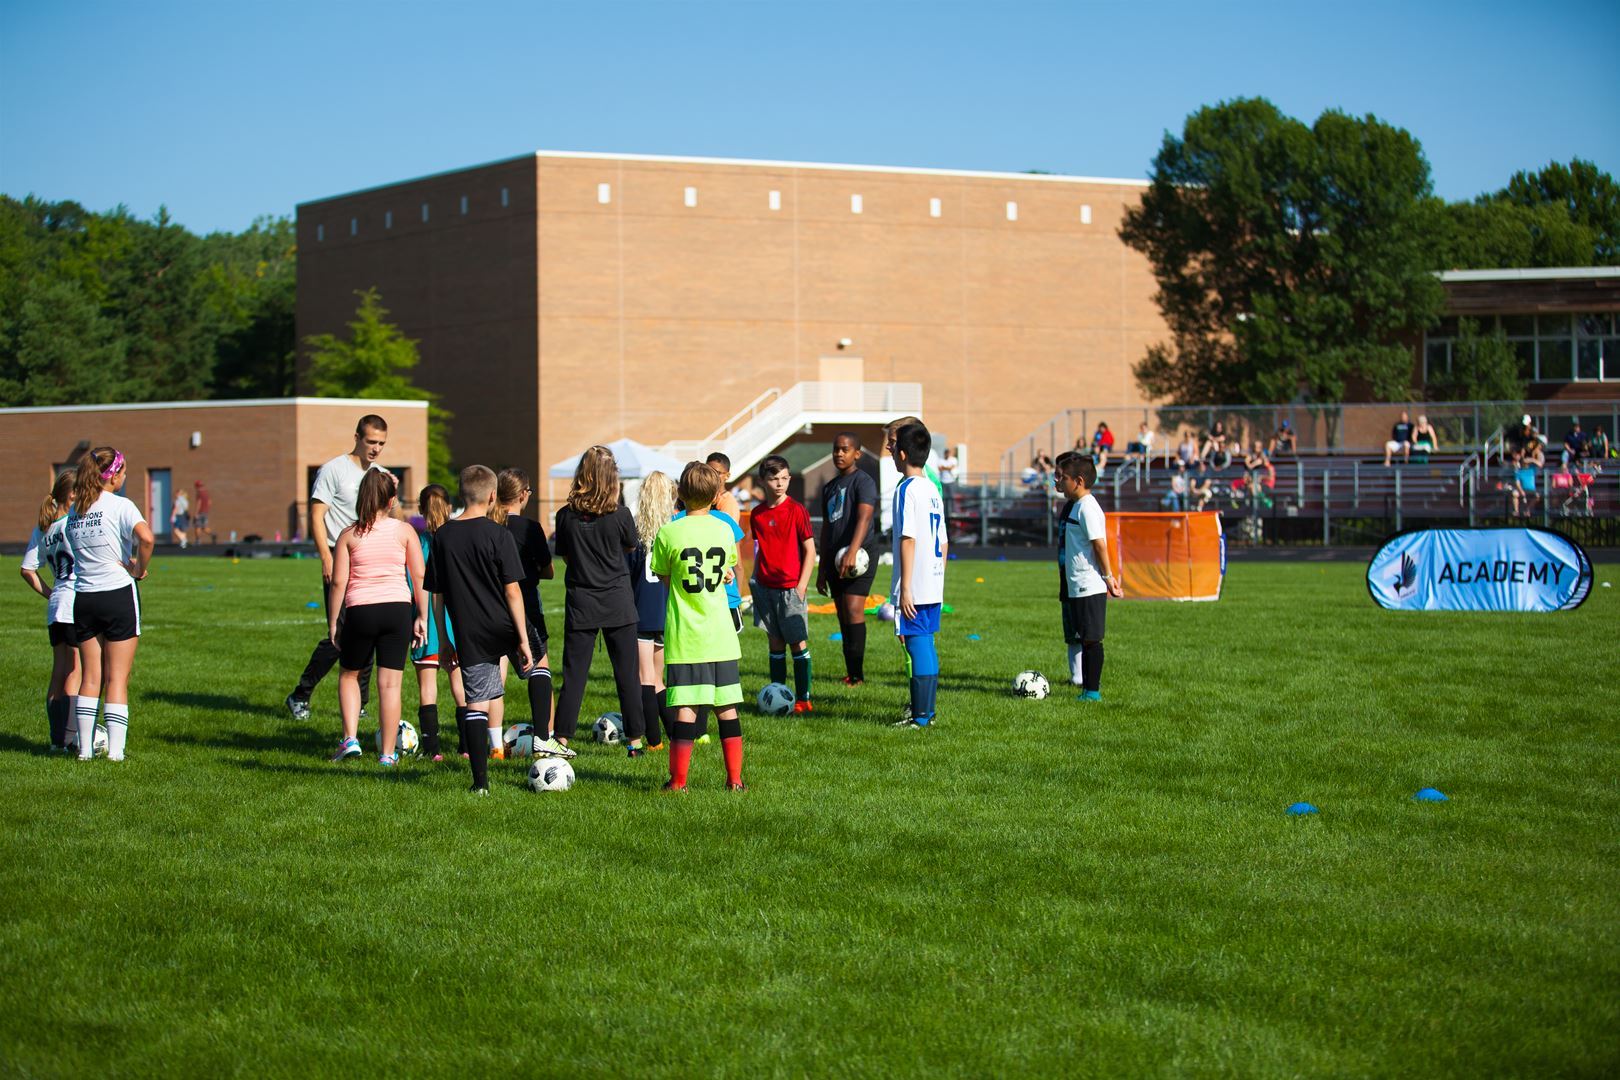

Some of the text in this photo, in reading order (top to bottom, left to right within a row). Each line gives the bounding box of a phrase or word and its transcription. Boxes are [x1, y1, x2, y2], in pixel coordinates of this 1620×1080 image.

[69, 519, 102, 530] START HERE
[47, 551, 74, 579] 10
[680, 547, 726, 593] 33
[1438, 560, 1565, 585] ACADEMY
